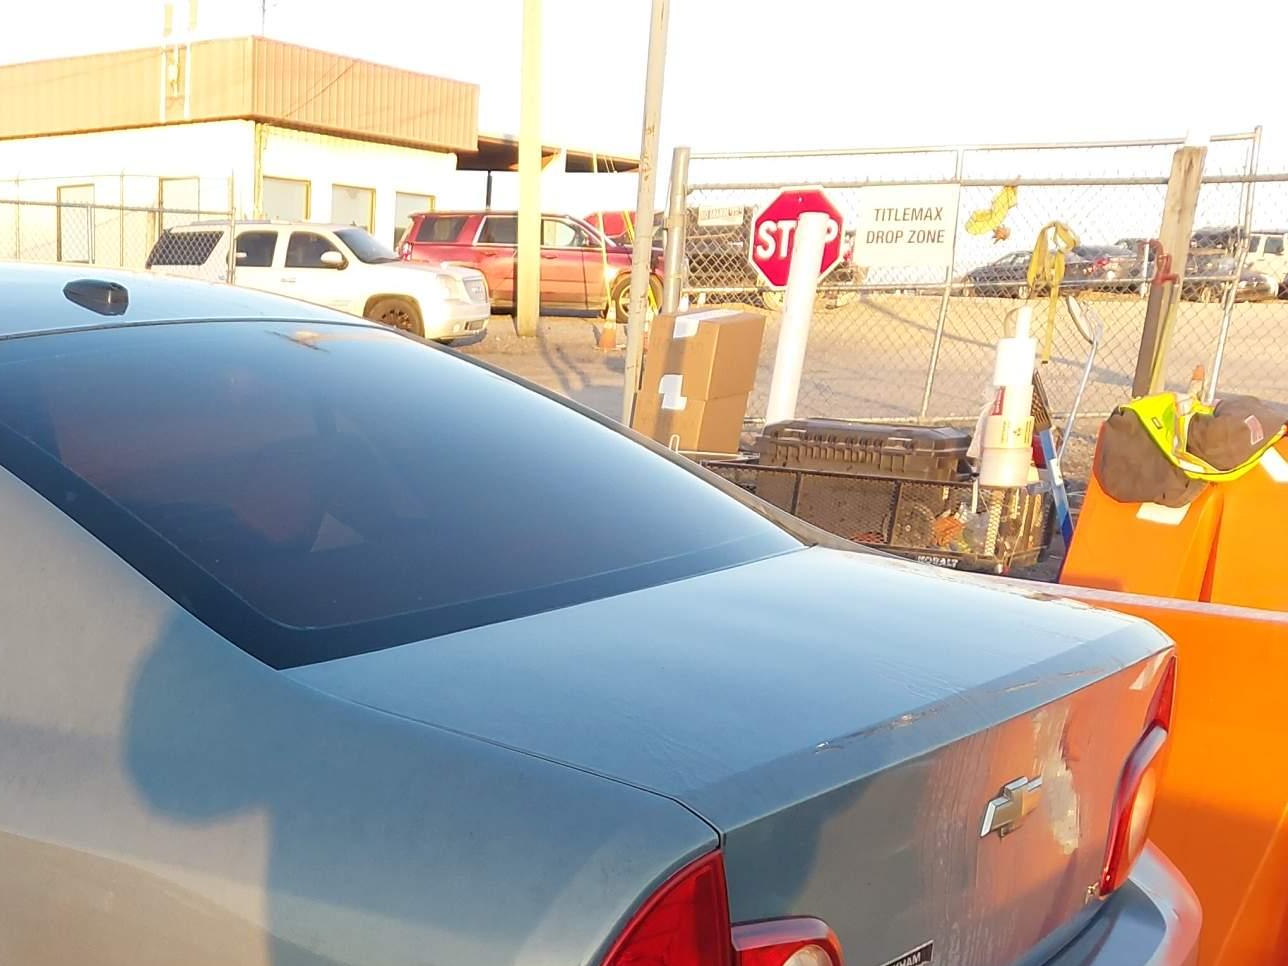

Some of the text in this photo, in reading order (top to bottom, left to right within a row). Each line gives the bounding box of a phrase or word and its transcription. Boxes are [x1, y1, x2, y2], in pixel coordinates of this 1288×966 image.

[873, 206, 944, 221] TITLEMAX
[756, 218, 839, 259] STP
[866, 229, 945, 244] DROP ZONE
